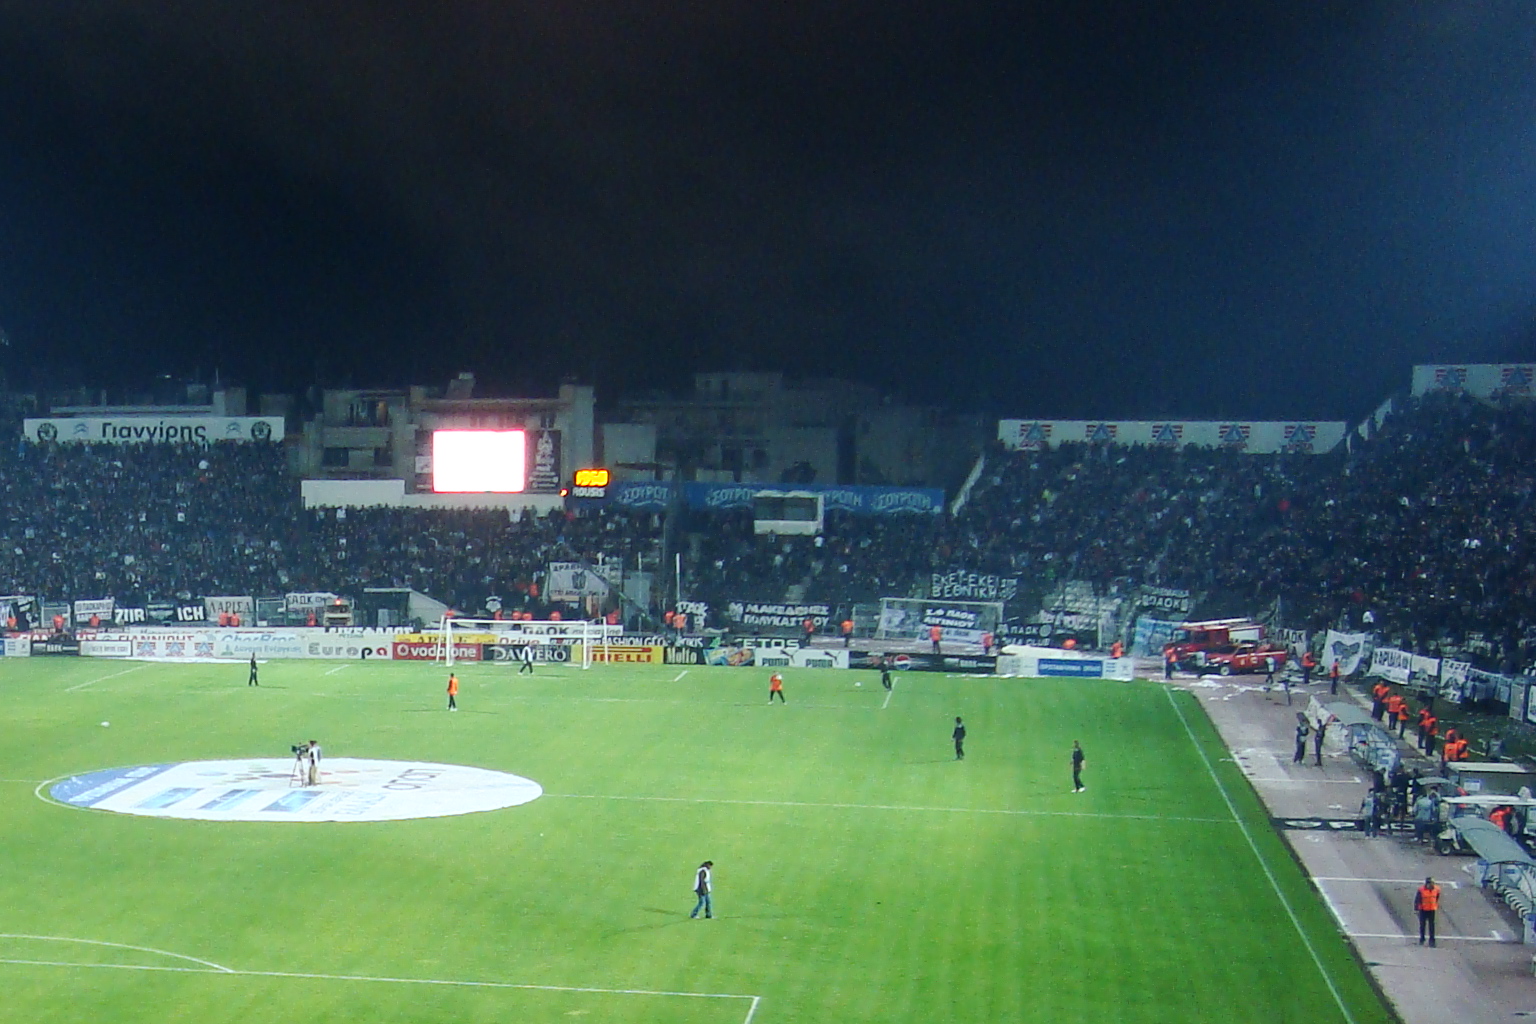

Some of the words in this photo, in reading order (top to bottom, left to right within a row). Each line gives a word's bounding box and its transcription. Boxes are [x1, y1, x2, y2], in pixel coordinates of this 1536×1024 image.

[410, 643, 477, 658] vodaone
[489, 646, 567, 662] DAVERO
[584, 653, 652, 663] IRELLI
